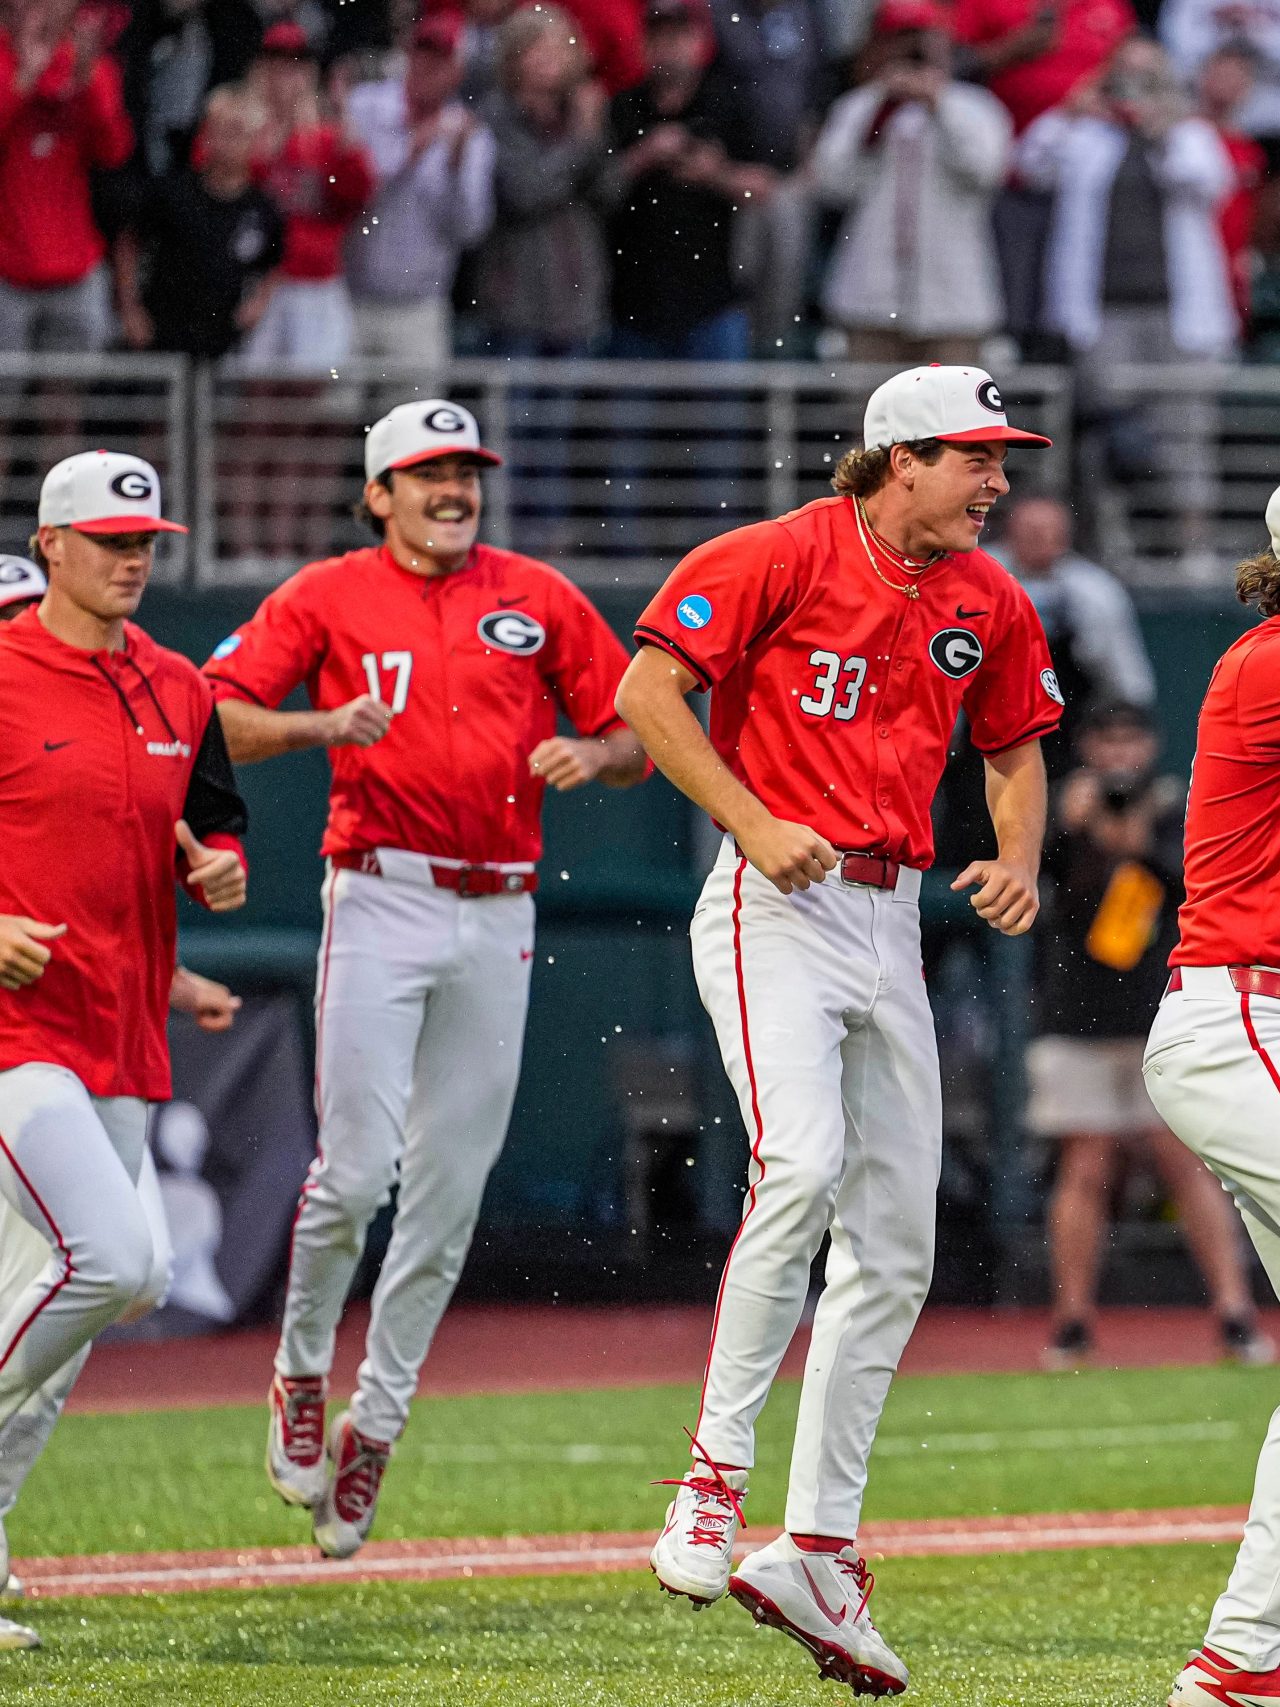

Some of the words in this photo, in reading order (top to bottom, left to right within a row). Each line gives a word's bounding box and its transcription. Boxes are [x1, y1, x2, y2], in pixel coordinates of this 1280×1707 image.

[429, 408, 466, 433] G
[117, 474, 153, 499] G
[490, 614, 545, 650] G
[361, 650, 413, 714] 17
[799, 649, 868, 721] 33
